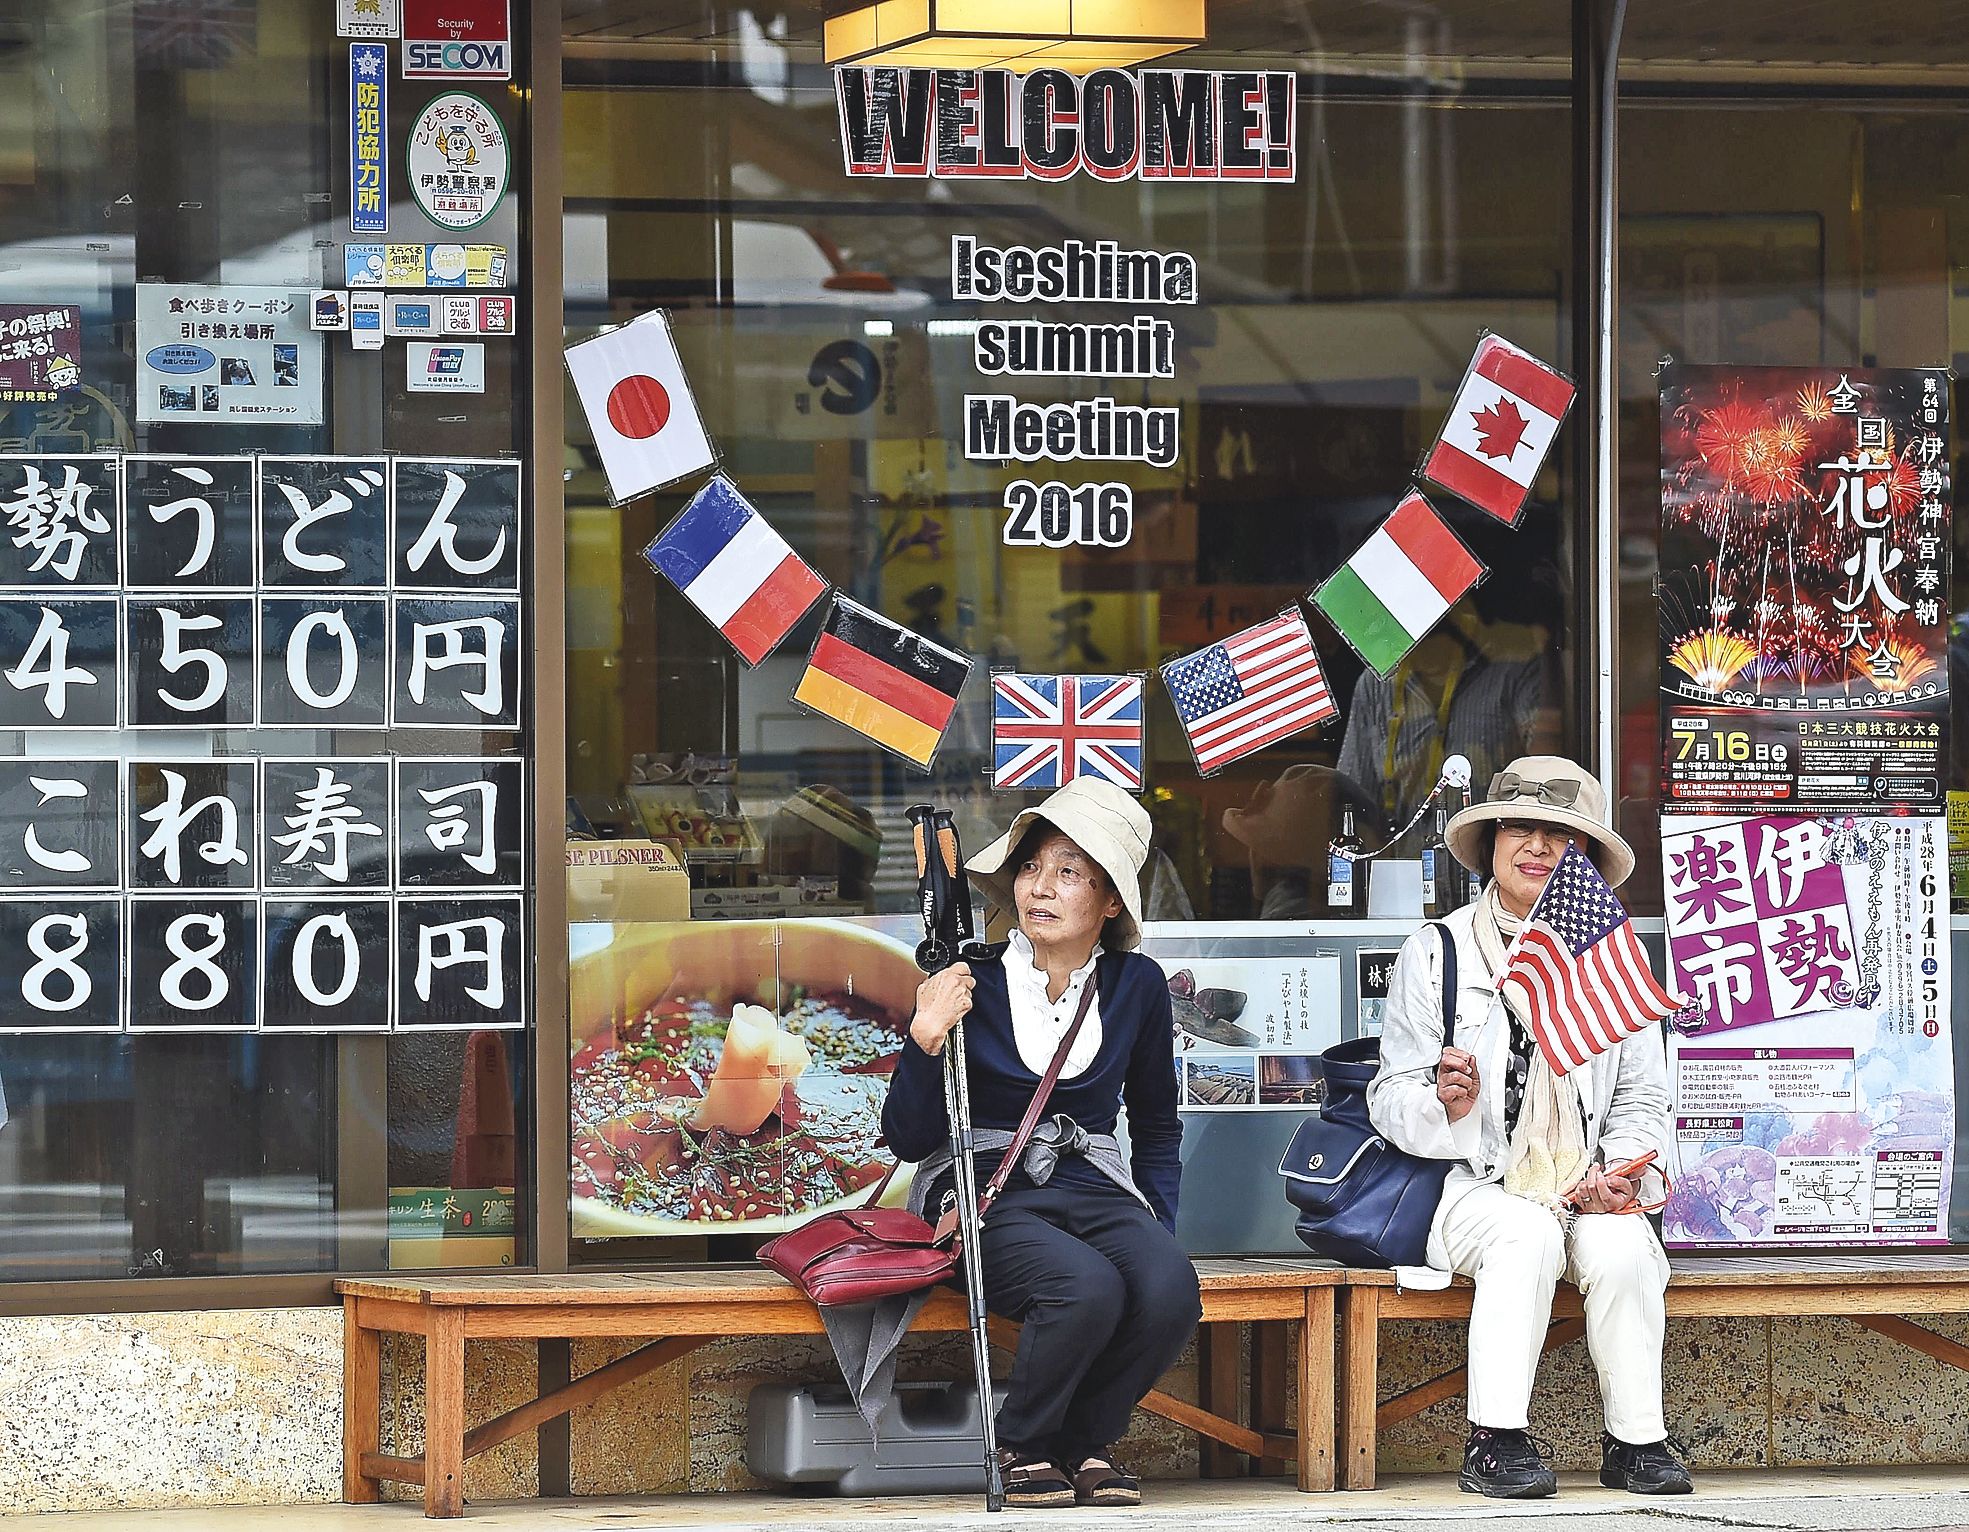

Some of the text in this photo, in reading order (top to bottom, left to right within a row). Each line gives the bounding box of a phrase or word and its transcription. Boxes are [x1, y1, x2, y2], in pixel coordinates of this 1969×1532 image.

[437, 18, 475, 31] Security
[450, 29, 462, 39] by
[409, 43, 504, 70] SECOM
[416, 104, 497, 149] こどもを守る所
[836, 66, 1296, 182] WELCOME!
[356, 82, 381, 213] 防犯協力所
[420, 173, 497, 191] 伊勢警察署
[389, 245, 424, 255] えらべる
[956, 237, 1198, 303] Iseshima
[168, 297, 295, 315] 食べ歩きクーポン
[450, 308, 471, 317] グルメ
[450, 318, 471, 329] ぴあ
[486, 308, 506, 316] グルメ
[180, 322, 277, 340] 引き換え場所
[974, 320, 1174, 376] summit
[431, 353, 462, 363] UnionPay
[1921, 377, 1940, 423] 第64回
[966, 396, 1180, 466] Meeting
[1, 465, 507, 581] 勢うどん
[1005, 483, 1132, 546] 2016
[1816, 372, 1912, 679] 全国花火大会
[1914, 435, 1945, 627] 伊勢神宮奉納
[3, 606, 506, 720] 450円
[1798, 722, 1940, 736] 日本三大競技花火大会
[23, 766, 500, 884] こね寿司
[589, 848, 666, 866] PILSNER
[1861, 821, 1891, 1010] 伊勢のええもん再発見!
[21, 911, 506, 1012] 880円
[419, 1195, 462, 1221] 生茶
